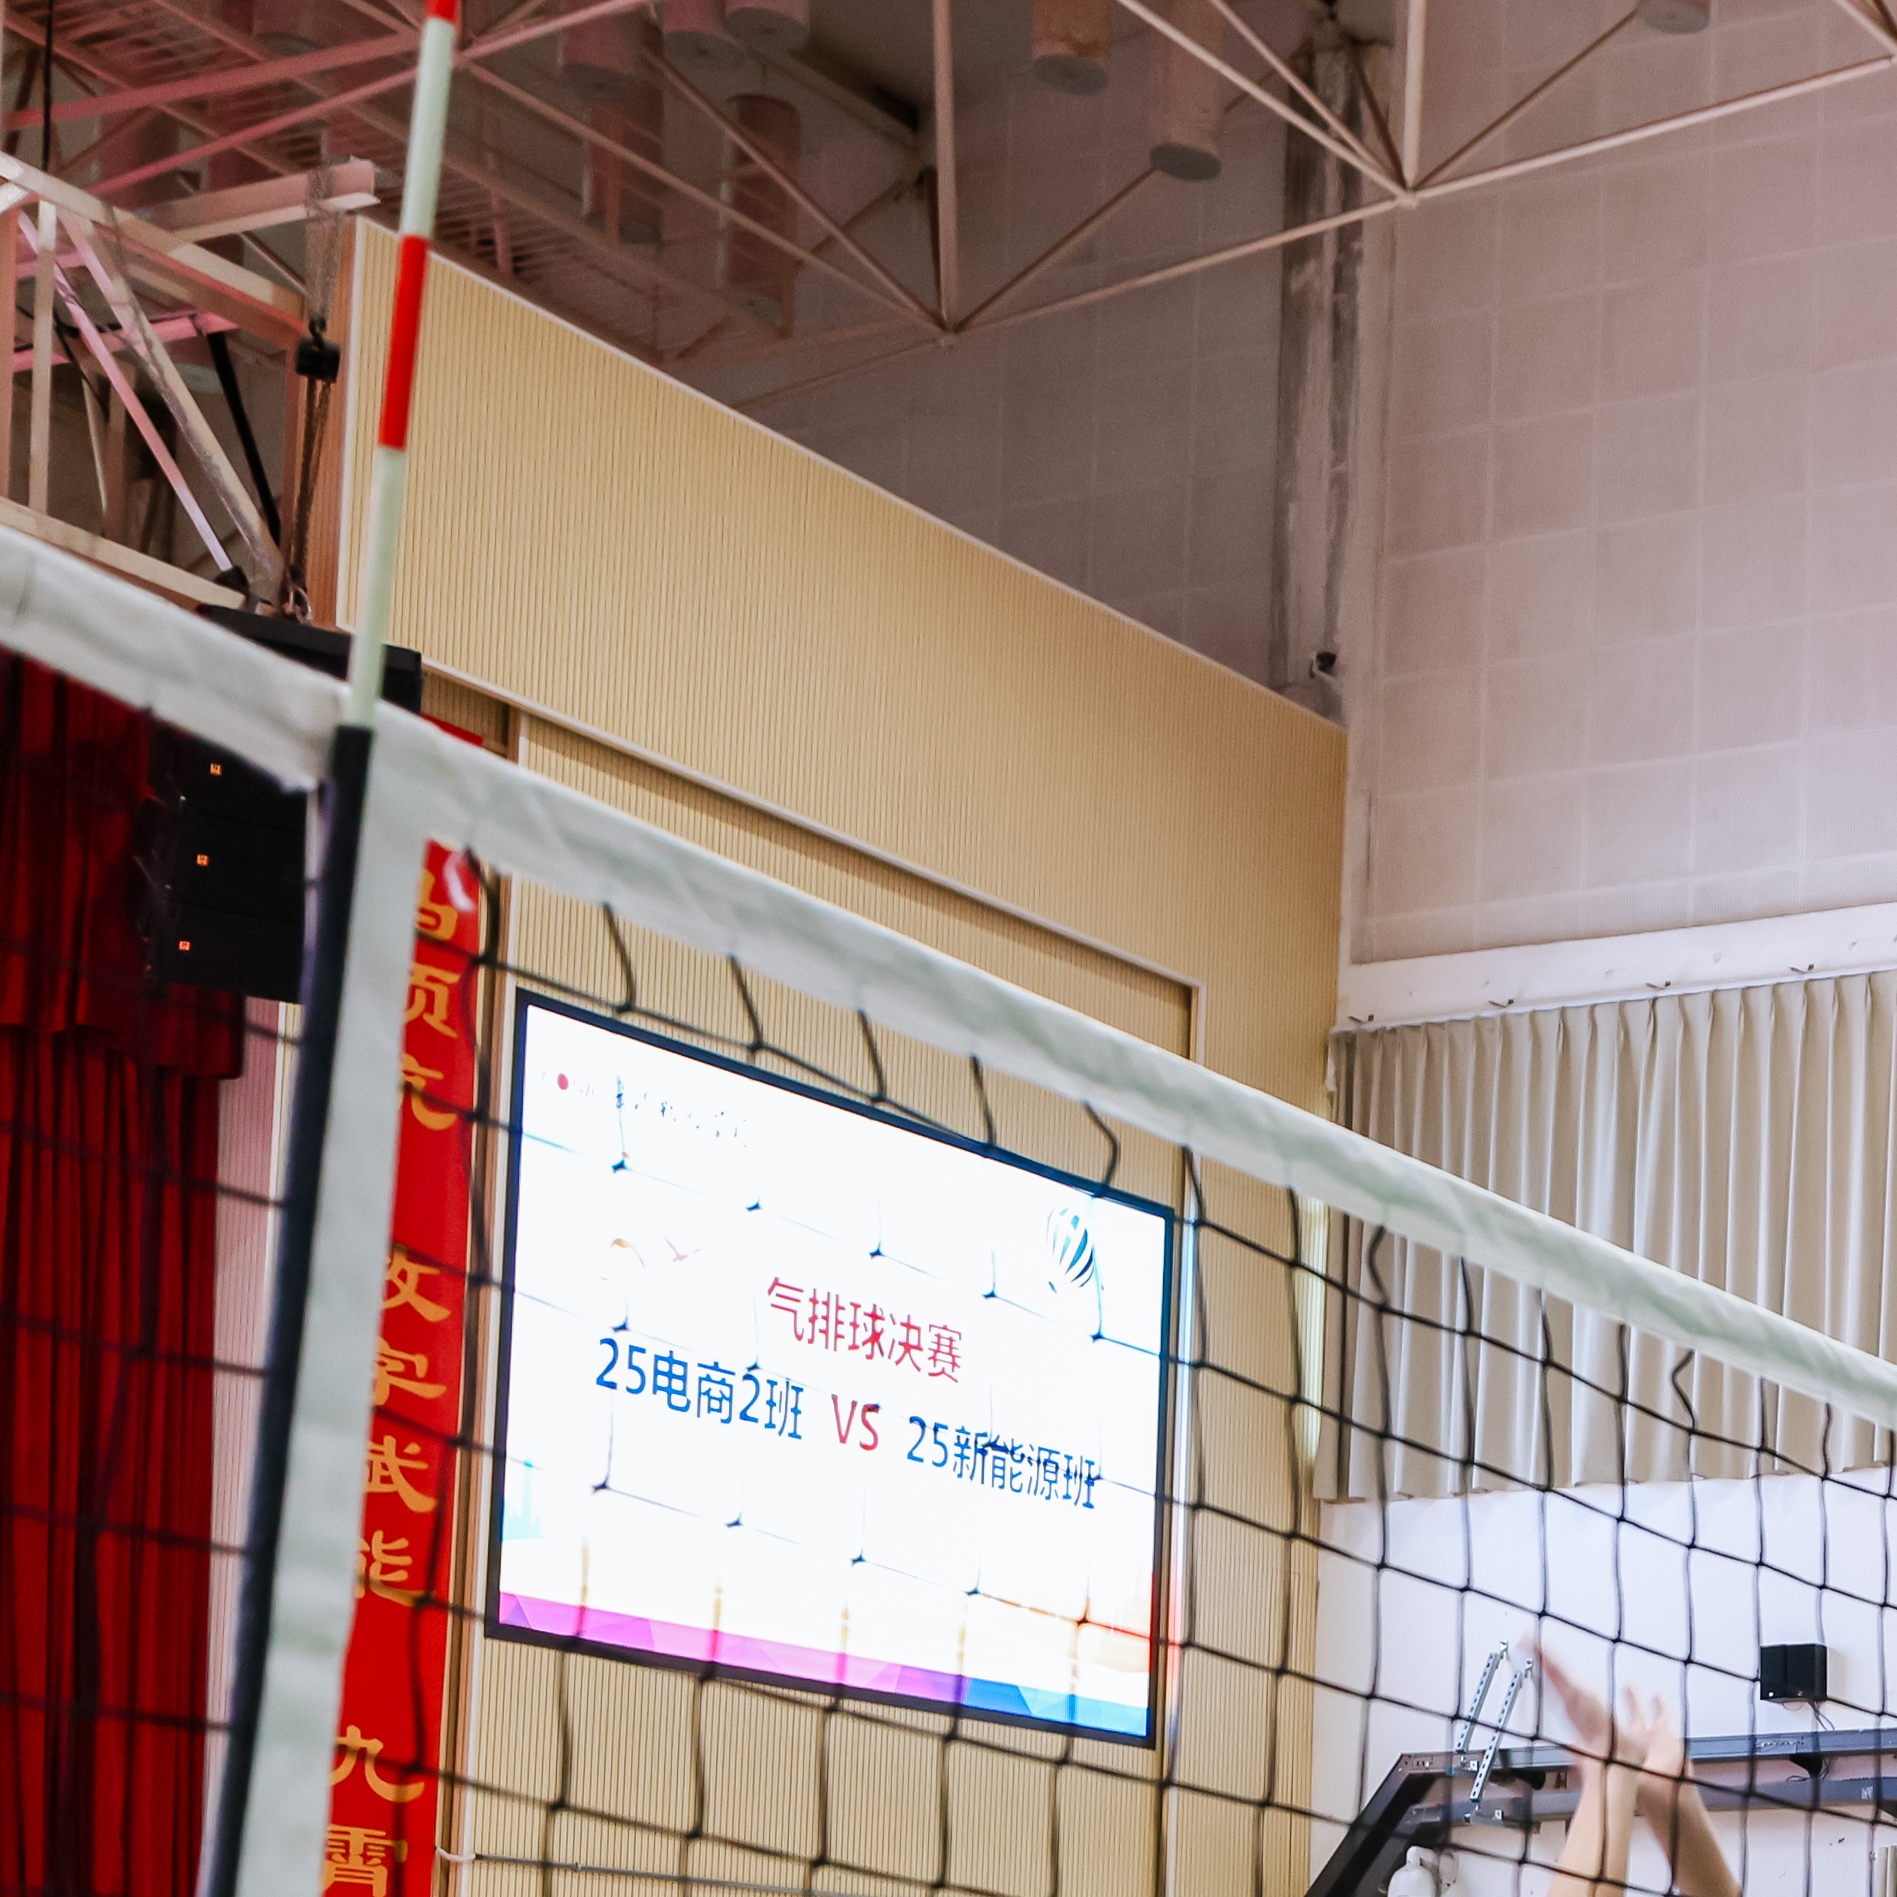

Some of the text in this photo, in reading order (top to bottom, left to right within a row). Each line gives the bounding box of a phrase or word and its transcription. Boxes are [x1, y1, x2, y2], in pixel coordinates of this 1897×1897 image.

[766, 1276, 963, 1383] 气排球决赛
[595, 1337, 1096, 1510] 25电商2班 VS 25新能源班
